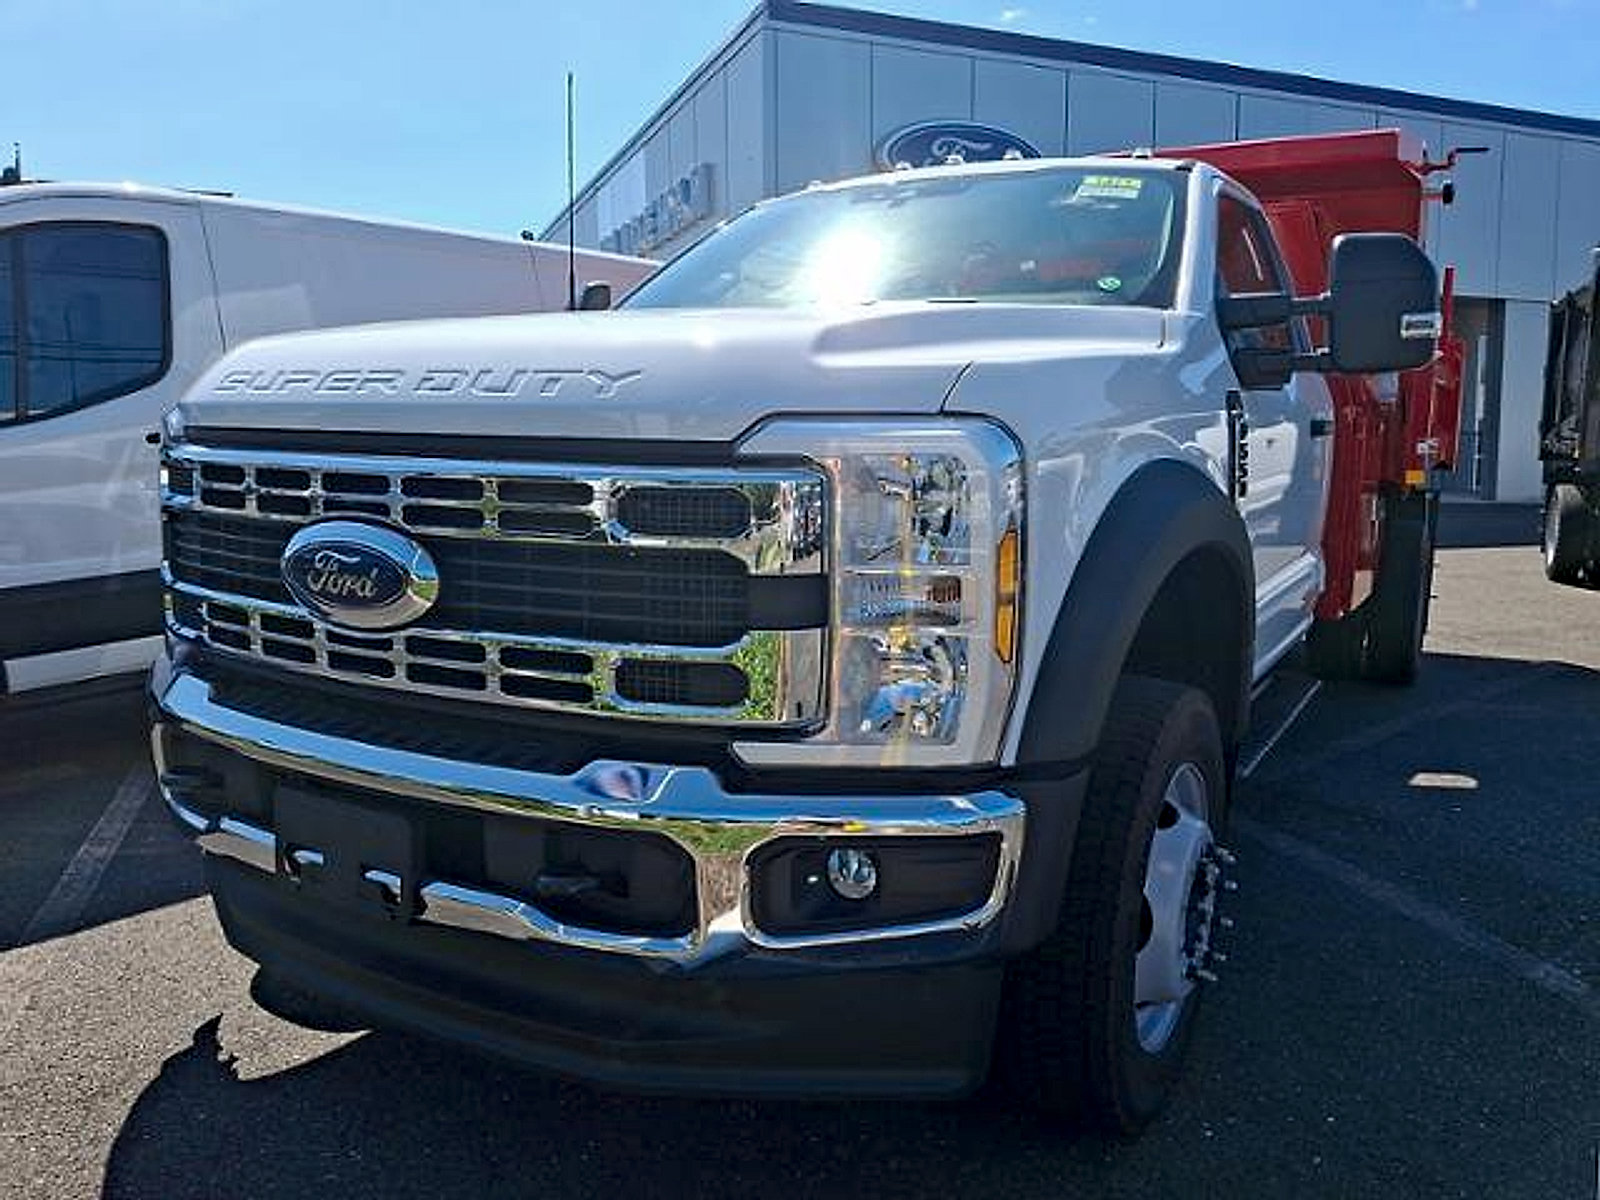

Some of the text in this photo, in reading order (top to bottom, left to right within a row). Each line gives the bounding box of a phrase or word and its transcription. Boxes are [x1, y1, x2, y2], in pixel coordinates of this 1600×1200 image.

[214, 367, 642, 399] SUPER DUTY
[306, 550, 379, 597] Ford
